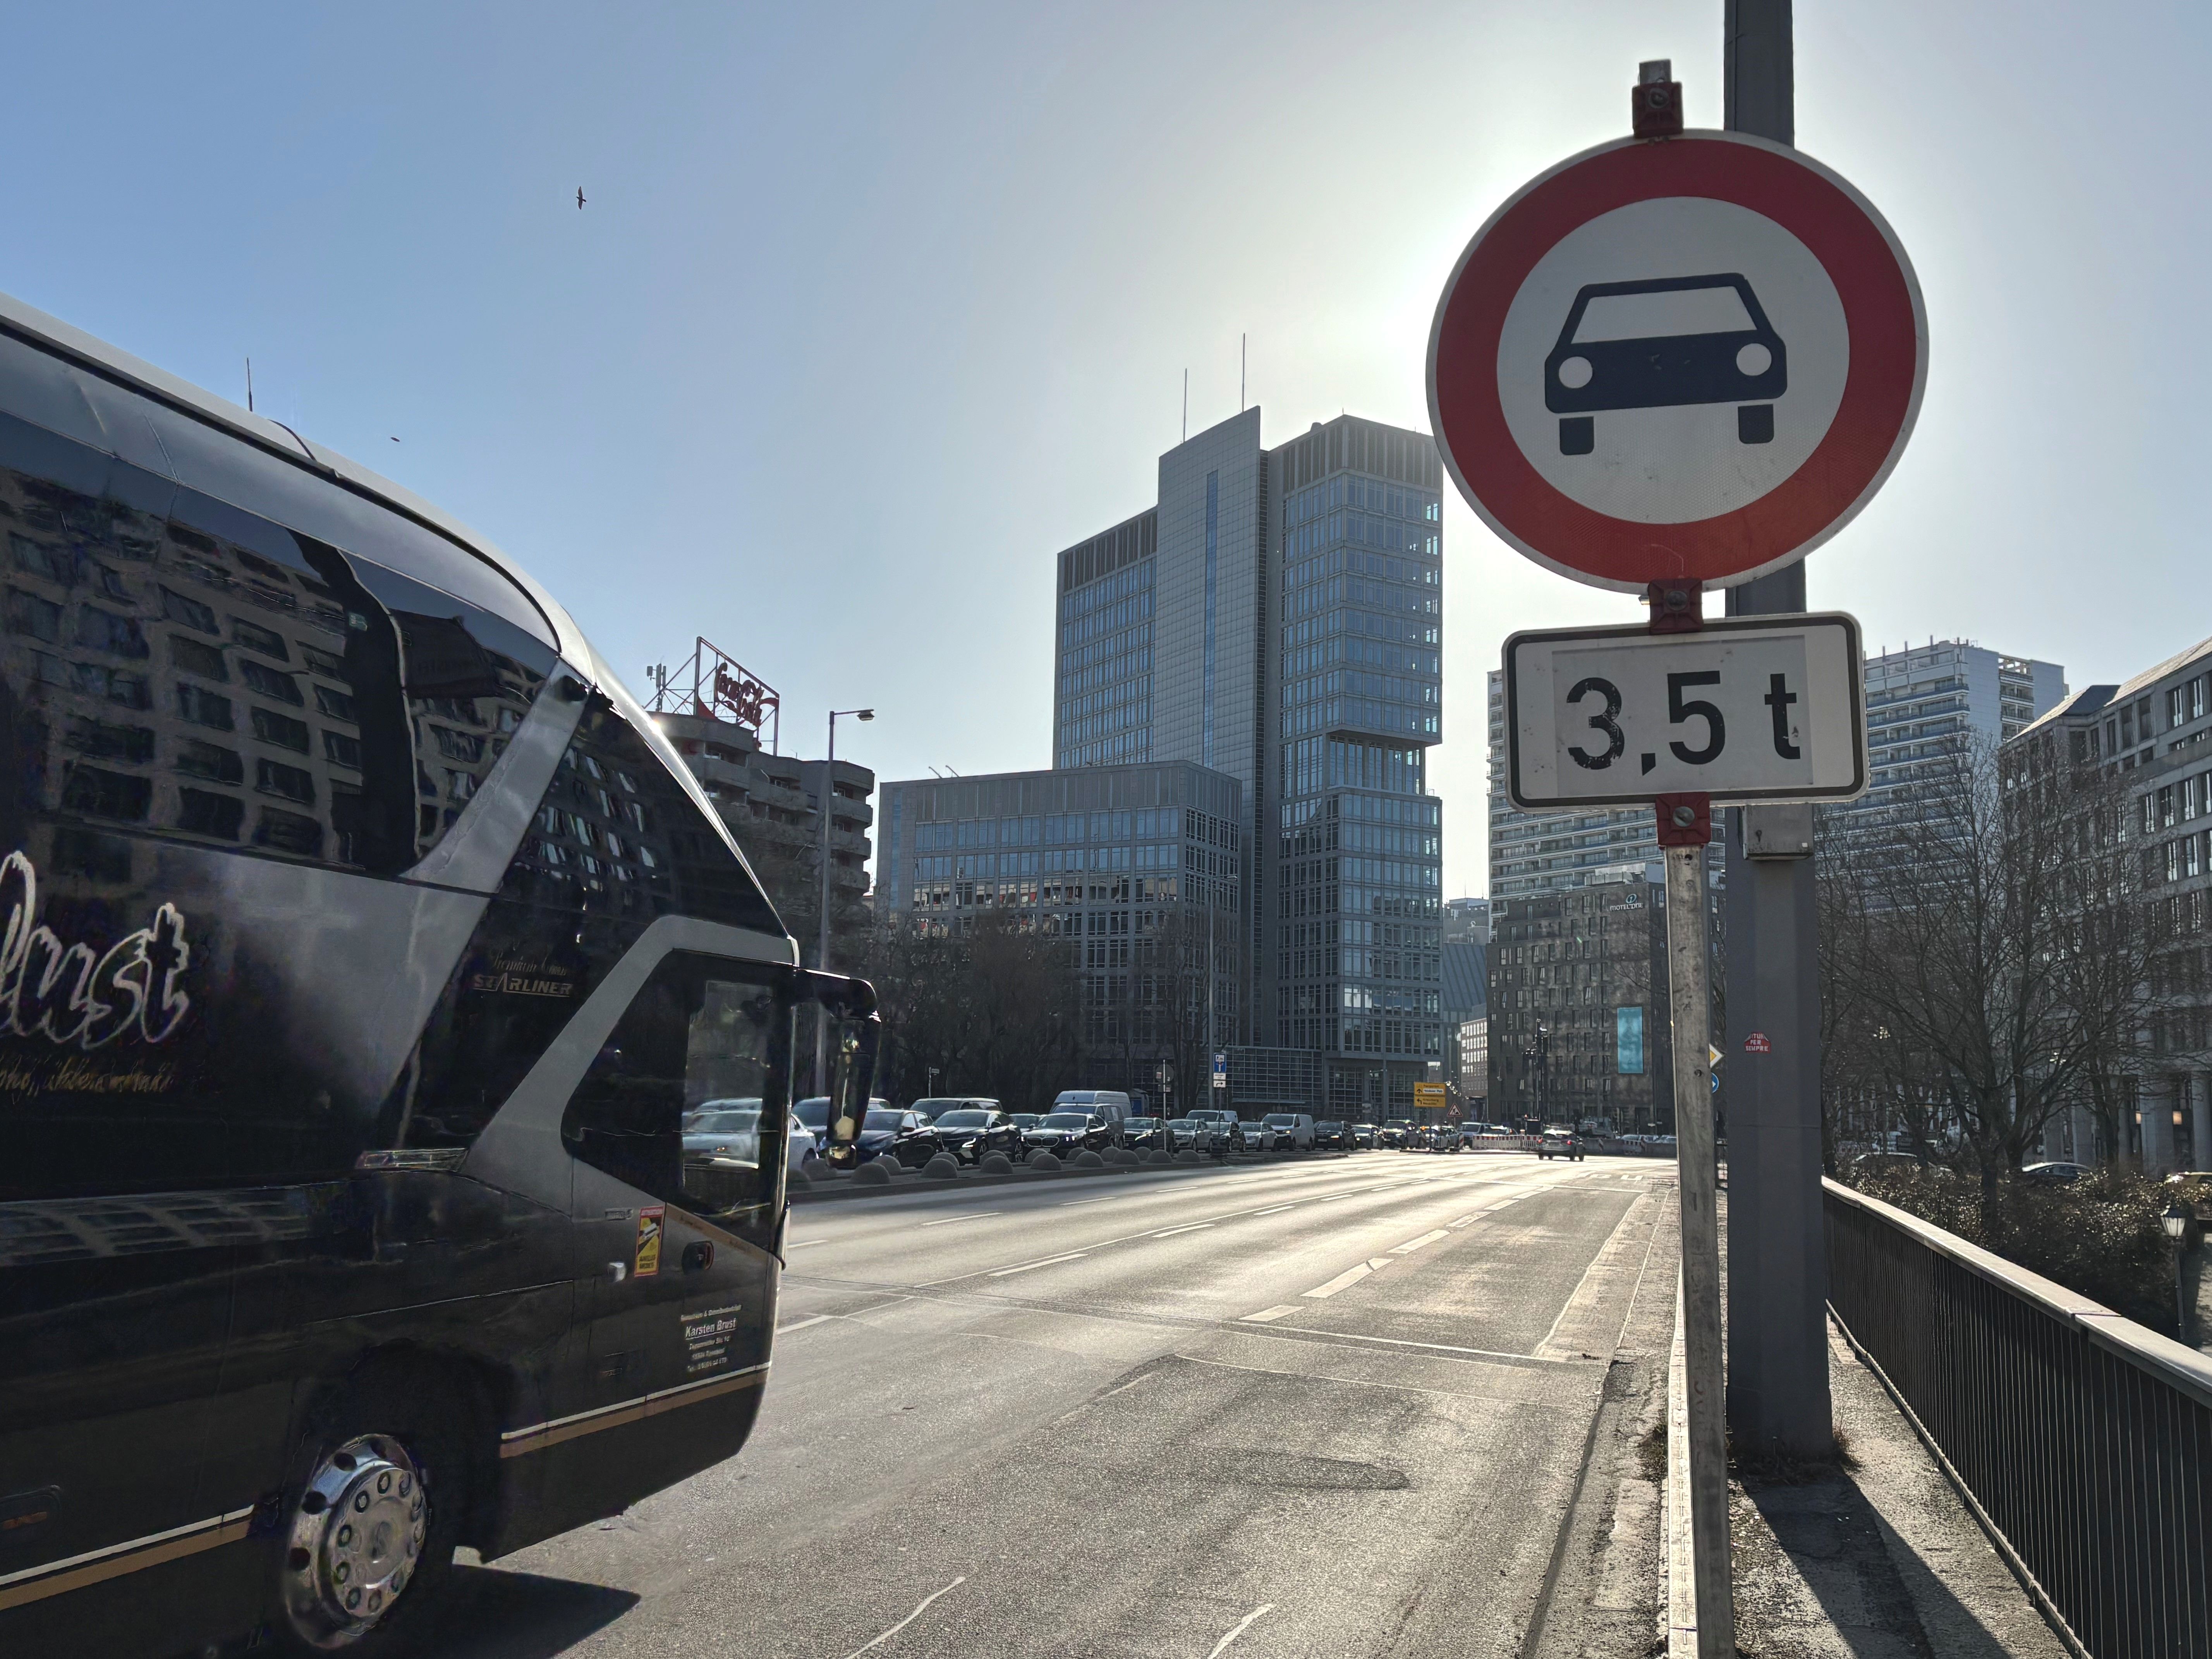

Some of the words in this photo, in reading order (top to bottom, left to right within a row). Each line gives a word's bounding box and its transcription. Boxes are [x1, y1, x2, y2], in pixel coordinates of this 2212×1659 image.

[1566, 670, 1726, 776] 3,5
[1764, 673, 1801, 759] t
[473, 972, 573, 996] STARLINER
[685, 1324, 715, 1337] Karsten
